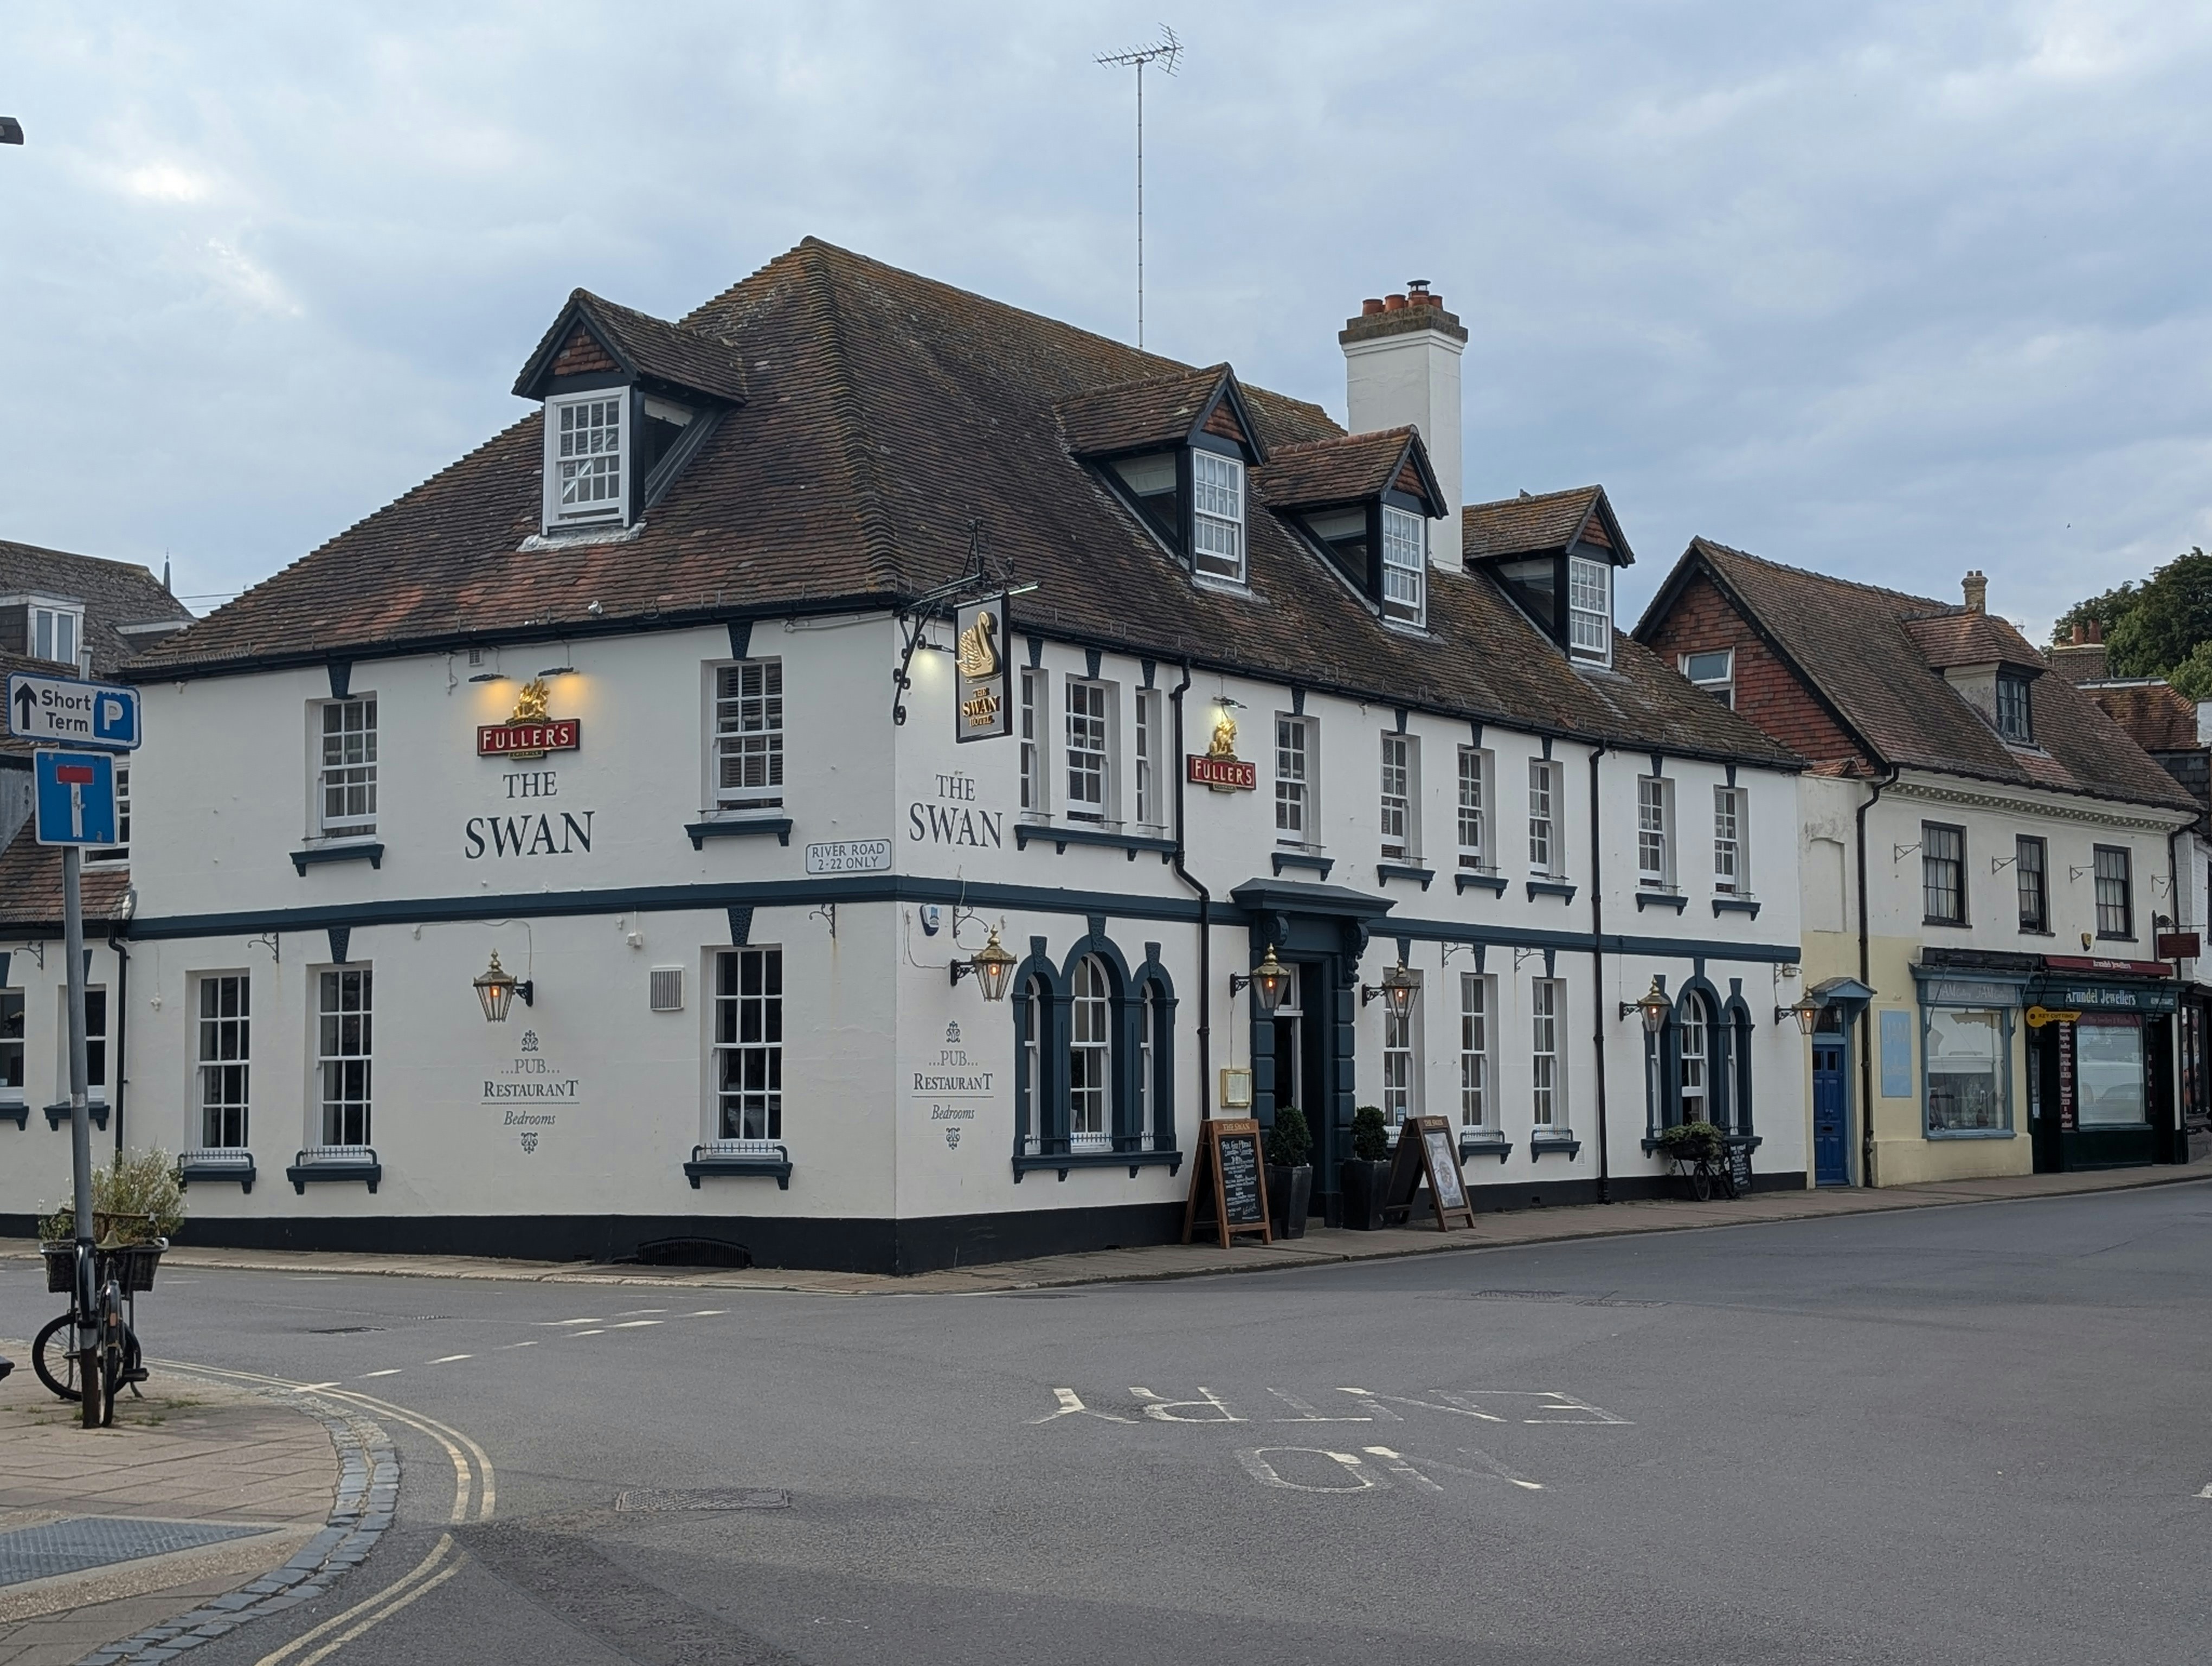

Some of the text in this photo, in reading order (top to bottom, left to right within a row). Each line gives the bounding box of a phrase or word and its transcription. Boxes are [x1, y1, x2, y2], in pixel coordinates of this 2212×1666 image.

[41, 689, 124, 731] Short P
[962, 695, 1000, 717] SWAN
[46, 712, 88, 732] Term
[483, 725, 569, 749] FULLER'S
[1195, 760, 1252, 785] FULLER'S
[503, 771, 558, 798] THE
[935, 774, 975, 802] THE
[465, 810, 595, 860] SWAN
[909, 802, 1003, 849] SWAN
[812, 843, 885, 858] RIVER ROAD
[846, 856, 878, 869] ONLY
[2065, 988, 2098, 1003] Arundel
[504, 1111, 556, 1125] Bedrooms
[931, 1104, 975, 1120] Bedrooms
